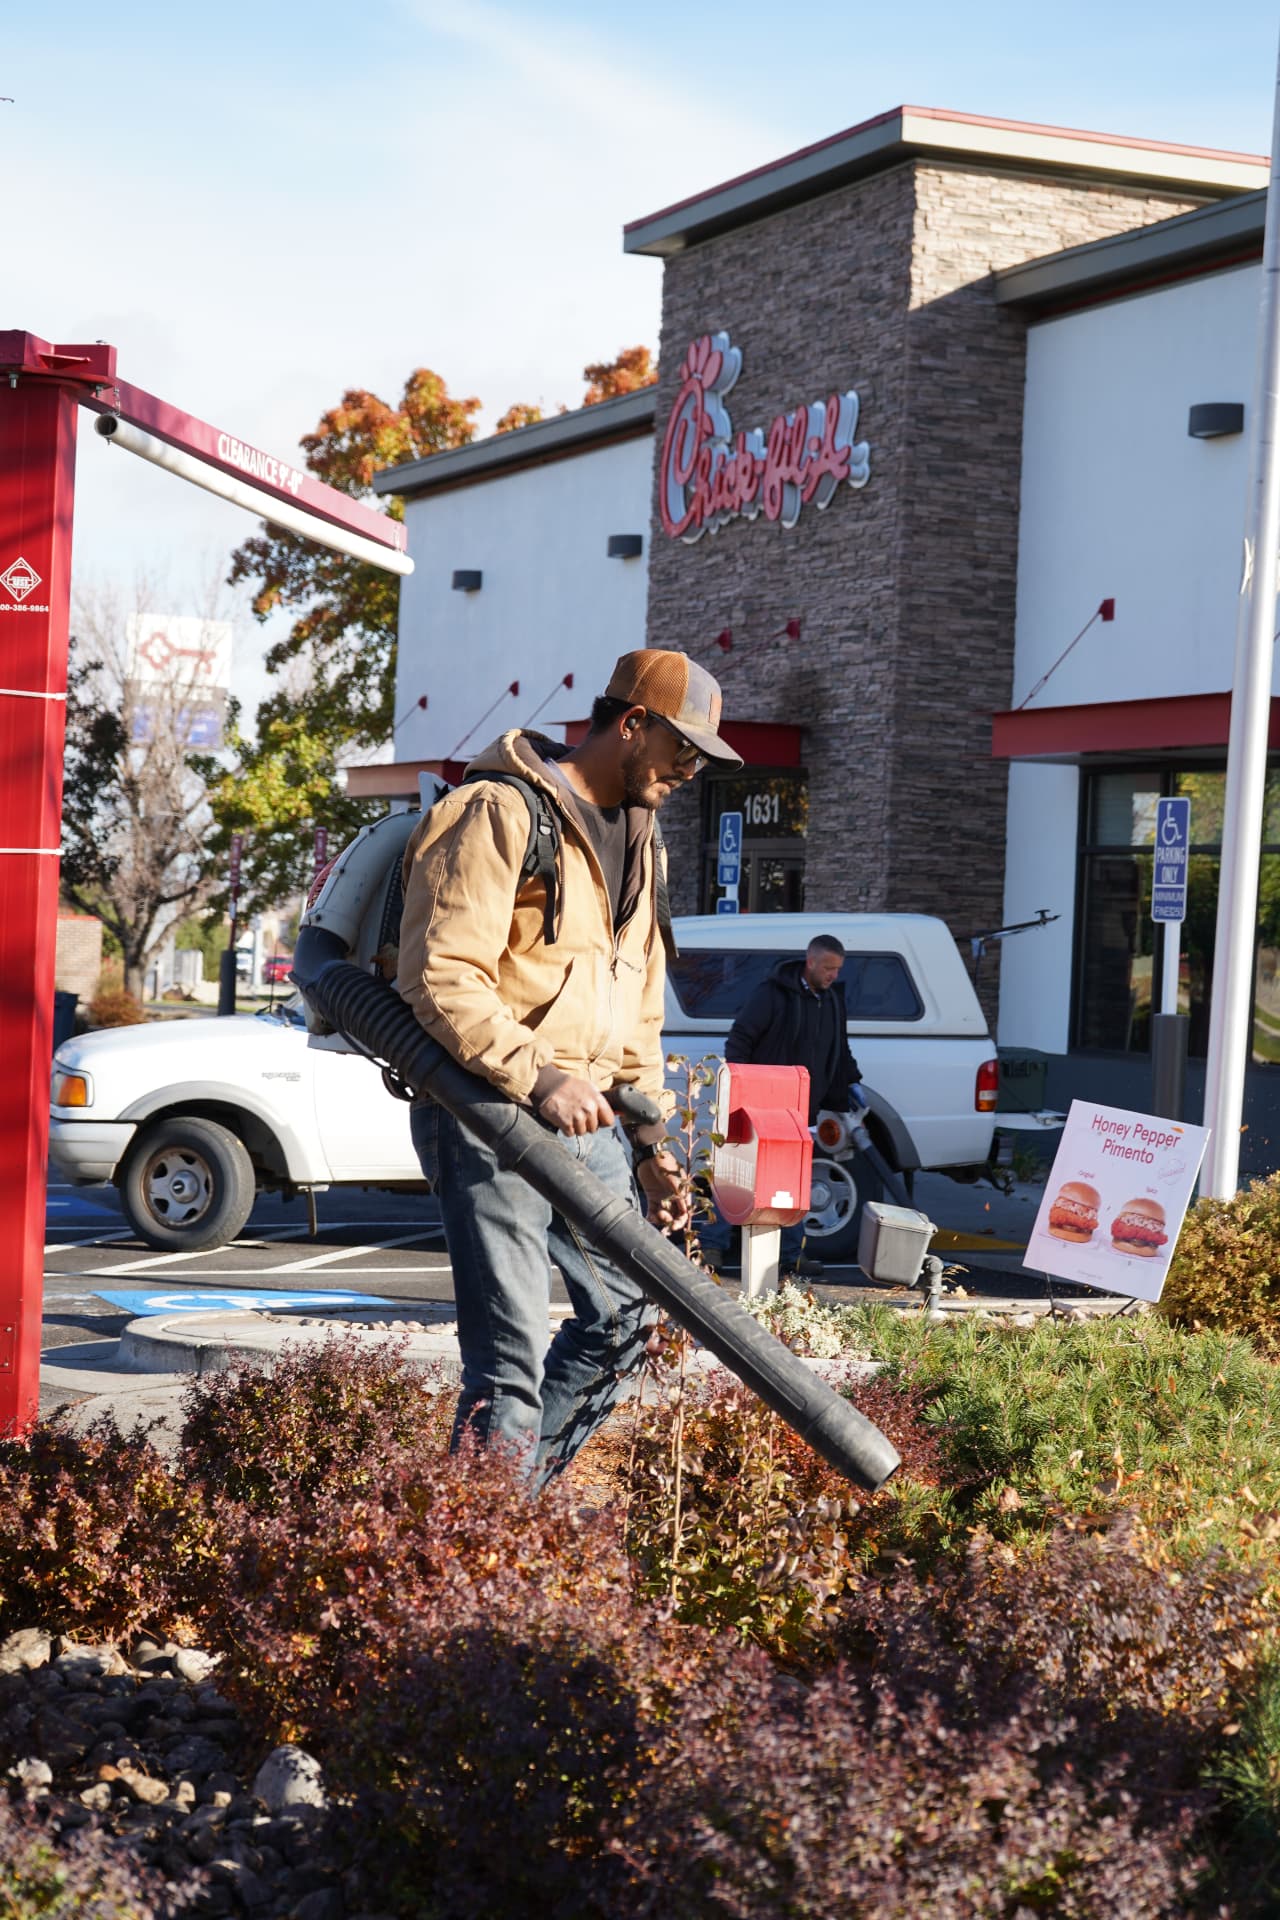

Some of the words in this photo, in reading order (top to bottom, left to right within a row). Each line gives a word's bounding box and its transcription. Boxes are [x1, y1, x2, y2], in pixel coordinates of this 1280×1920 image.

[660, 333, 862, 541] Chick-fil-A
[218, 433, 277, 485] CLEARANCE
[744, 793, 779, 825] 1631
[1157, 847, 1186, 864] PARKING
[1161, 866, 1180, 883] ONLY
[1091, 1114, 1131, 1140] Honey
[1132, 1123, 1181, 1149] Pepper
[1102, 1138, 1154, 1164] Pimento
